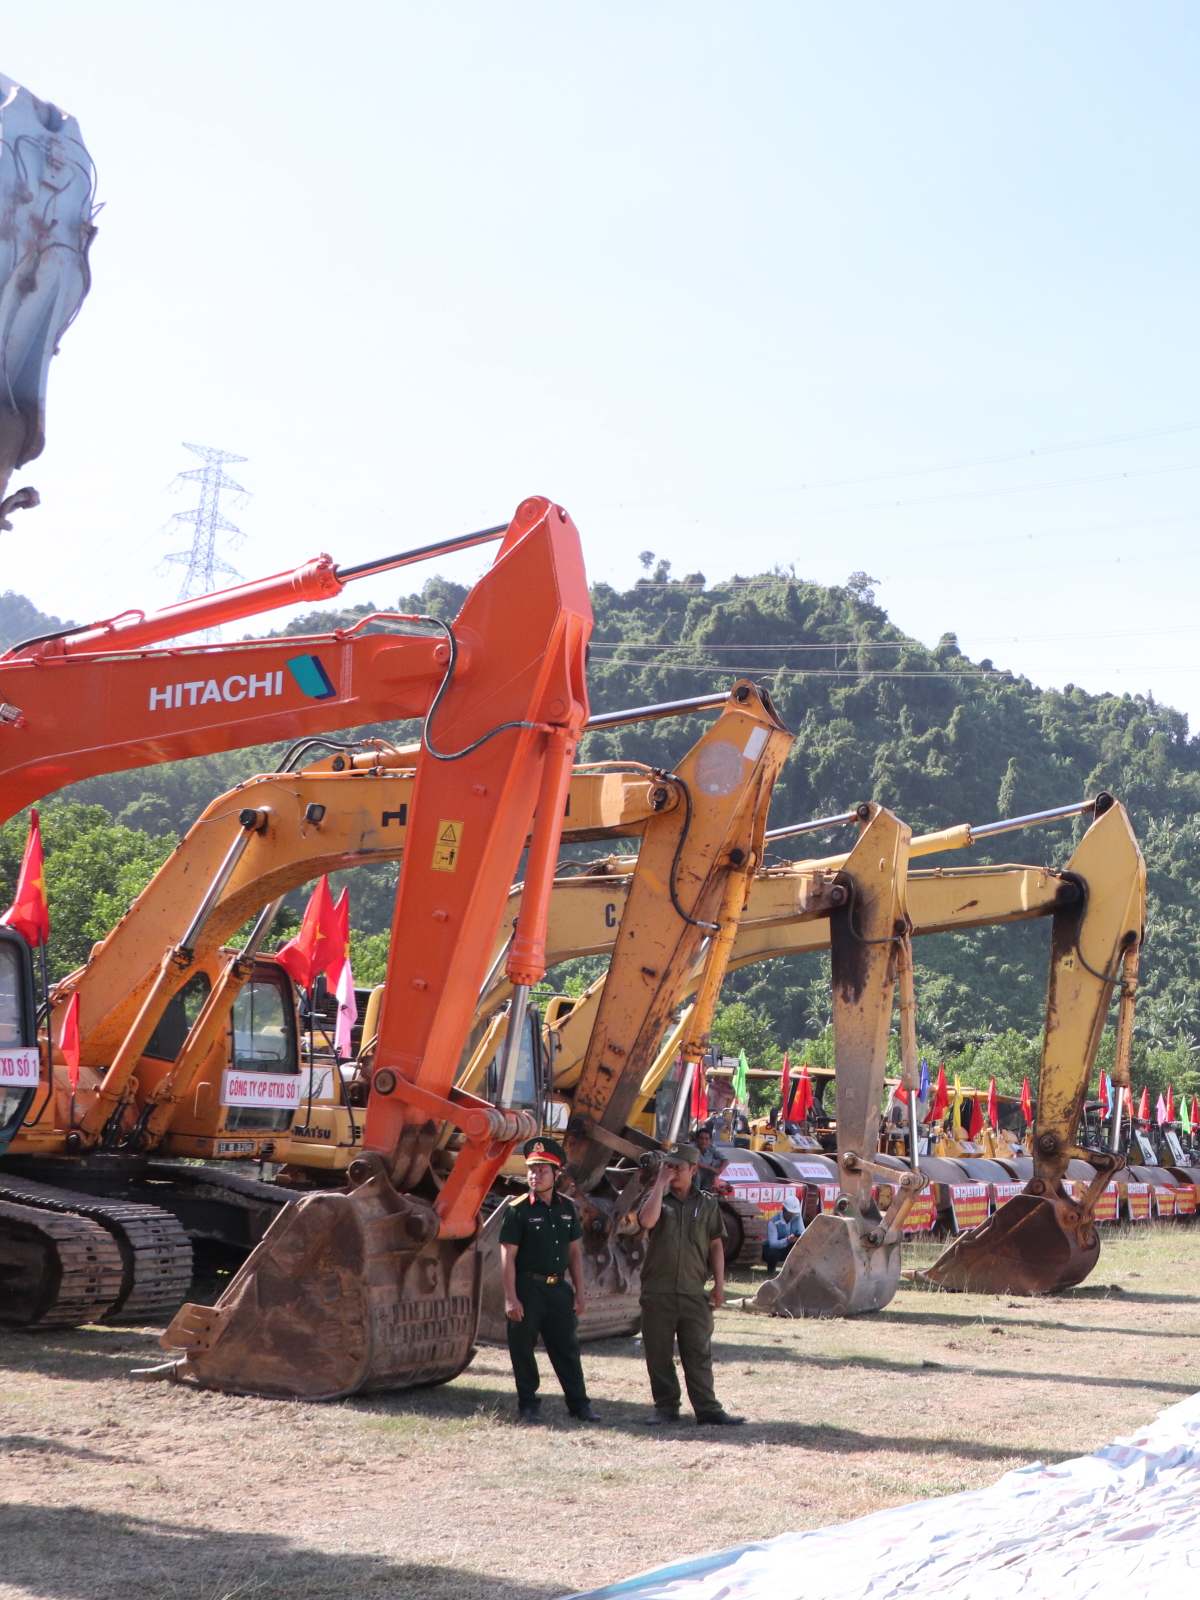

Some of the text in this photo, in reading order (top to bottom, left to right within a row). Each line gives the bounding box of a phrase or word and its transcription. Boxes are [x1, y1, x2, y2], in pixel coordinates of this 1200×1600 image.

[149, 671, 283, 711] HITACHI
[17, 1052, 30, 1077] SỐ
[32, 1059, 37, 1077] 1
[229, 1076, 247, 1097] CÔNG
[249, 1081, 258, 1097] TY
[258, 1081, 267, 1097] CP
[268, 1081, 285, 1098] GTXD
[286, 1078, 296, 1099] SỐ
[291, 1126, 331, 1139] MATSU
